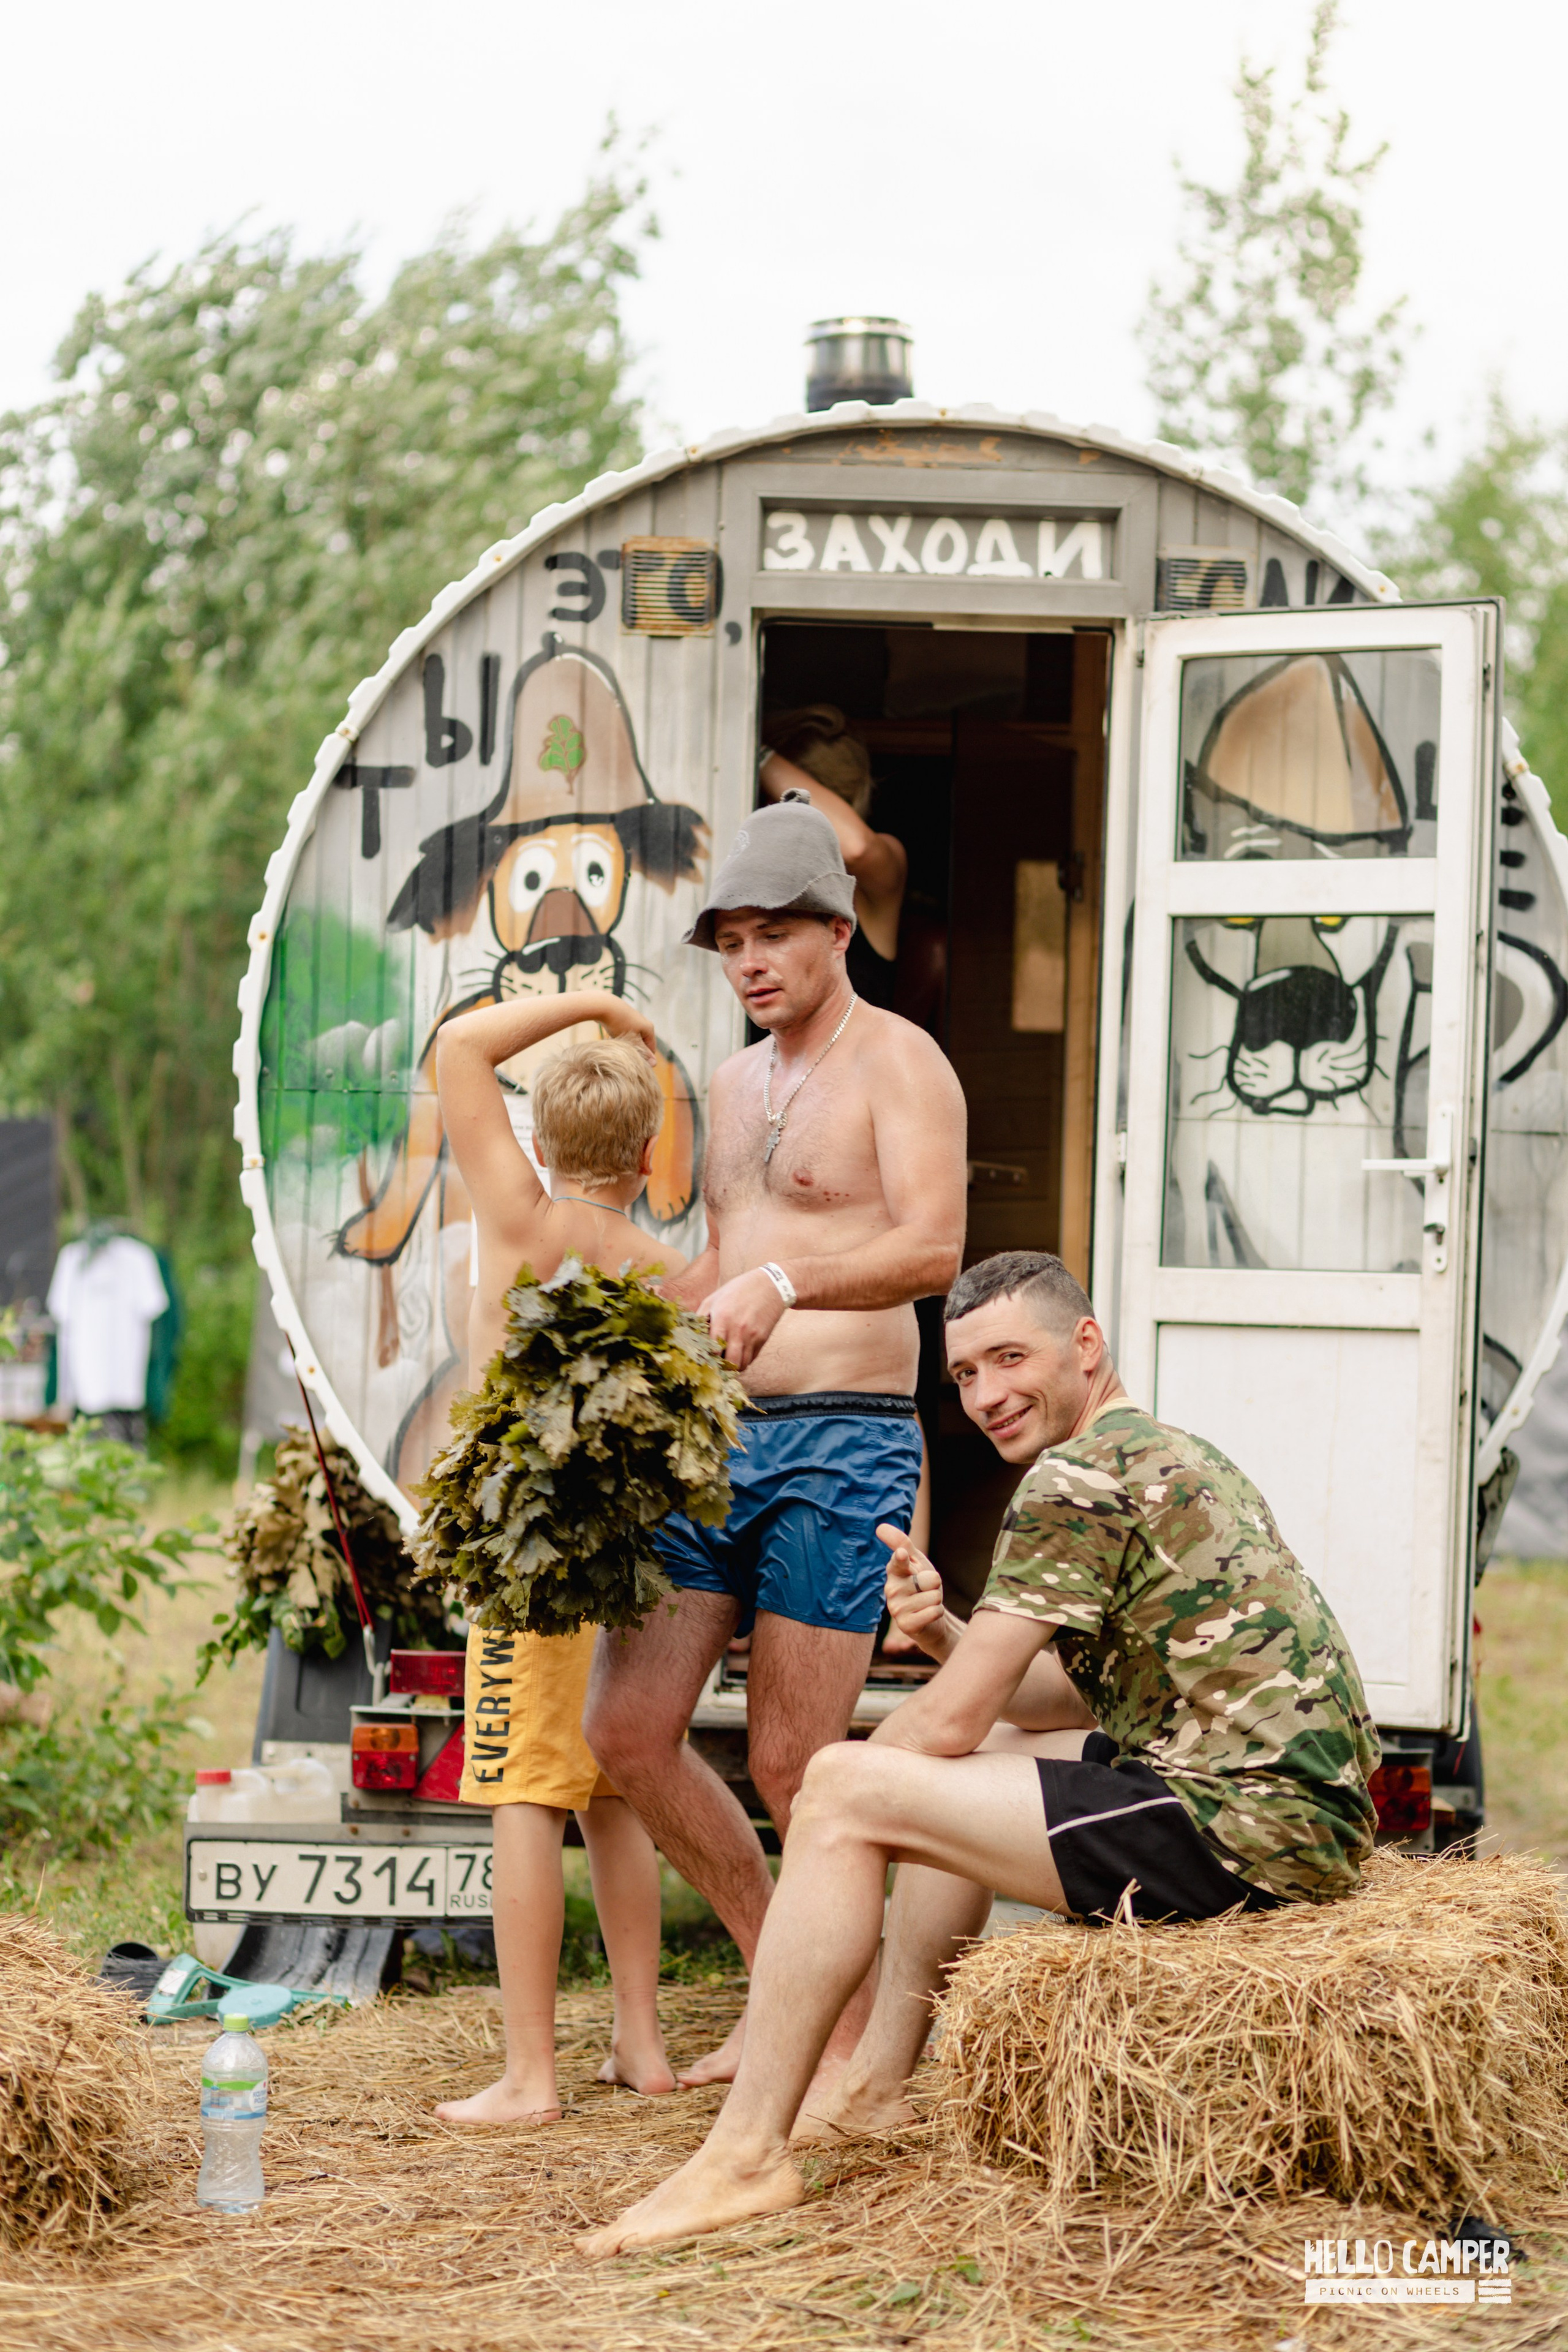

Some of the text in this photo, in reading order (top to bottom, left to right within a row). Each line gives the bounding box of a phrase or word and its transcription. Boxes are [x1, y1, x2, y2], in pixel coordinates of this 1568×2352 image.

[764, 511, 1102, 579] ЗАХОДИ
[470, 1624, 515, 1783] EVERYW
[298, 1853, 435, 1907] 7314
[450, 1894, 488, 1908] RUS
